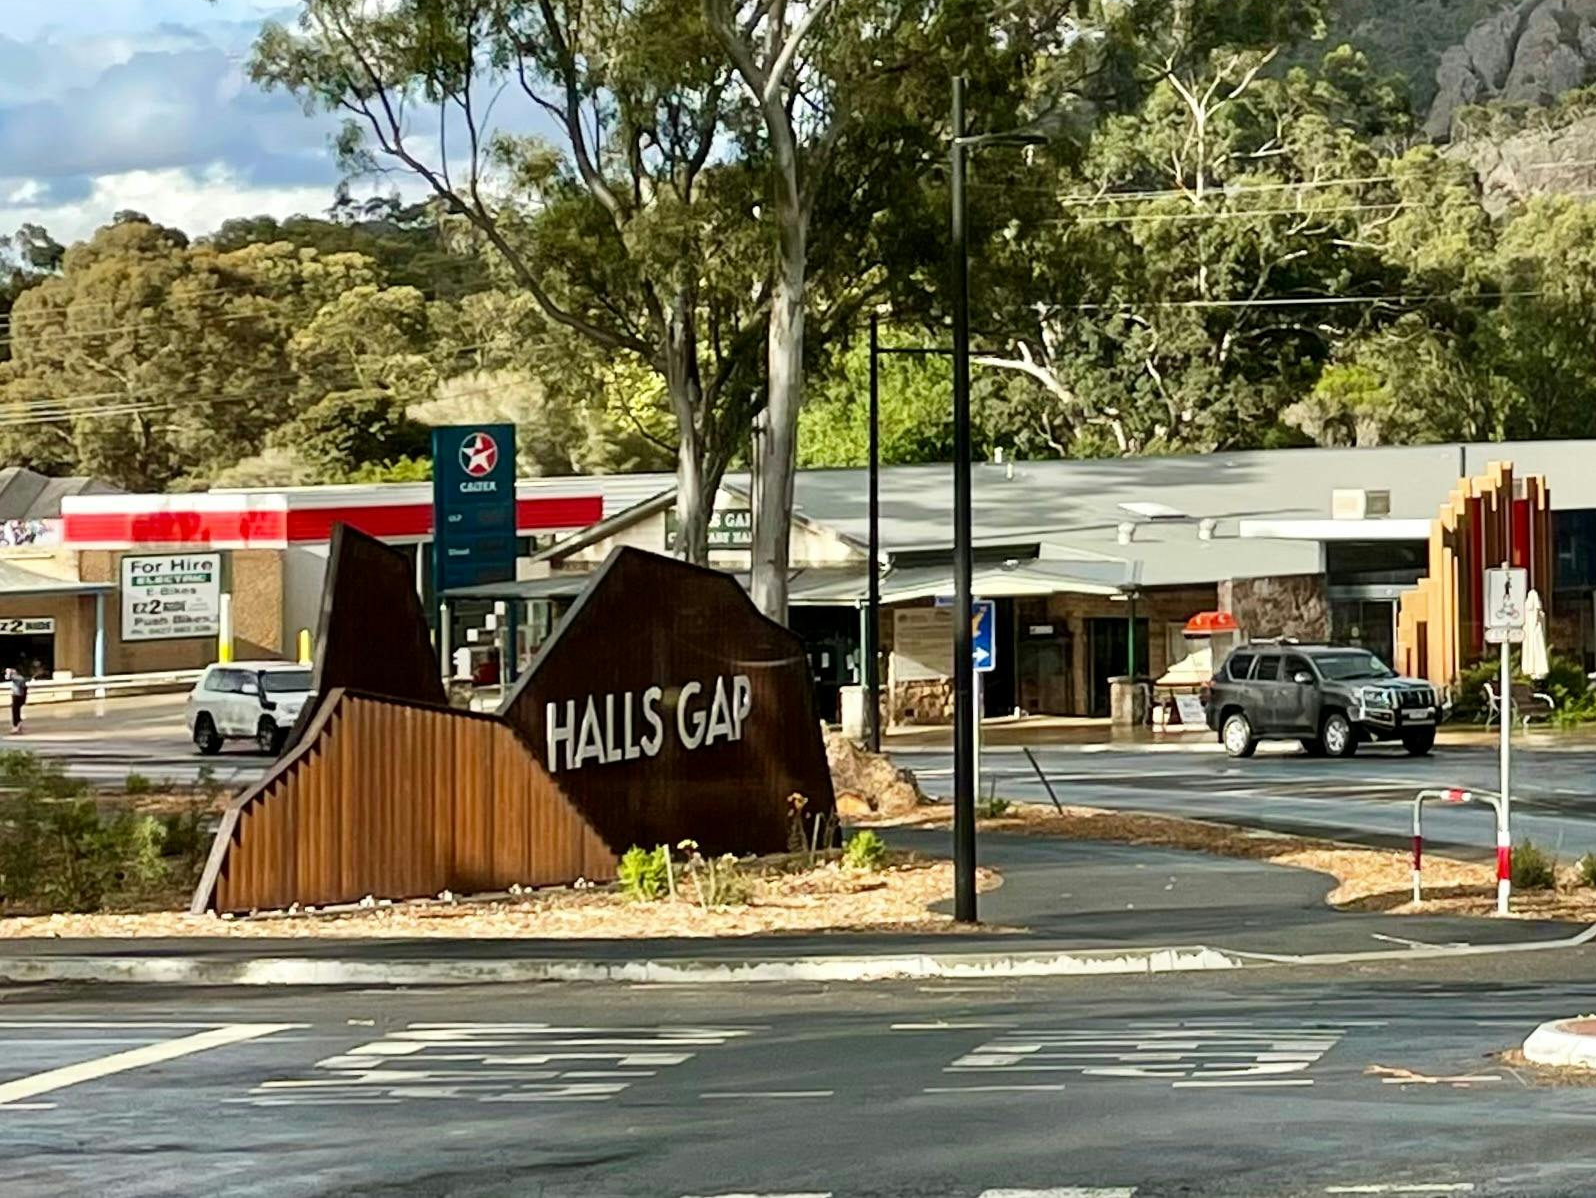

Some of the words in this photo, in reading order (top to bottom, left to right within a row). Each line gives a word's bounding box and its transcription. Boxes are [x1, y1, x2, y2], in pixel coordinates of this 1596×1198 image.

[460, 482, 497, 492] CALTEX
[131, 561, 162, 574] For
[170, 558, 212, 571] Hire
[547, 686, 663, 772] HALLS
[677, 675, 751, 749] GAP
